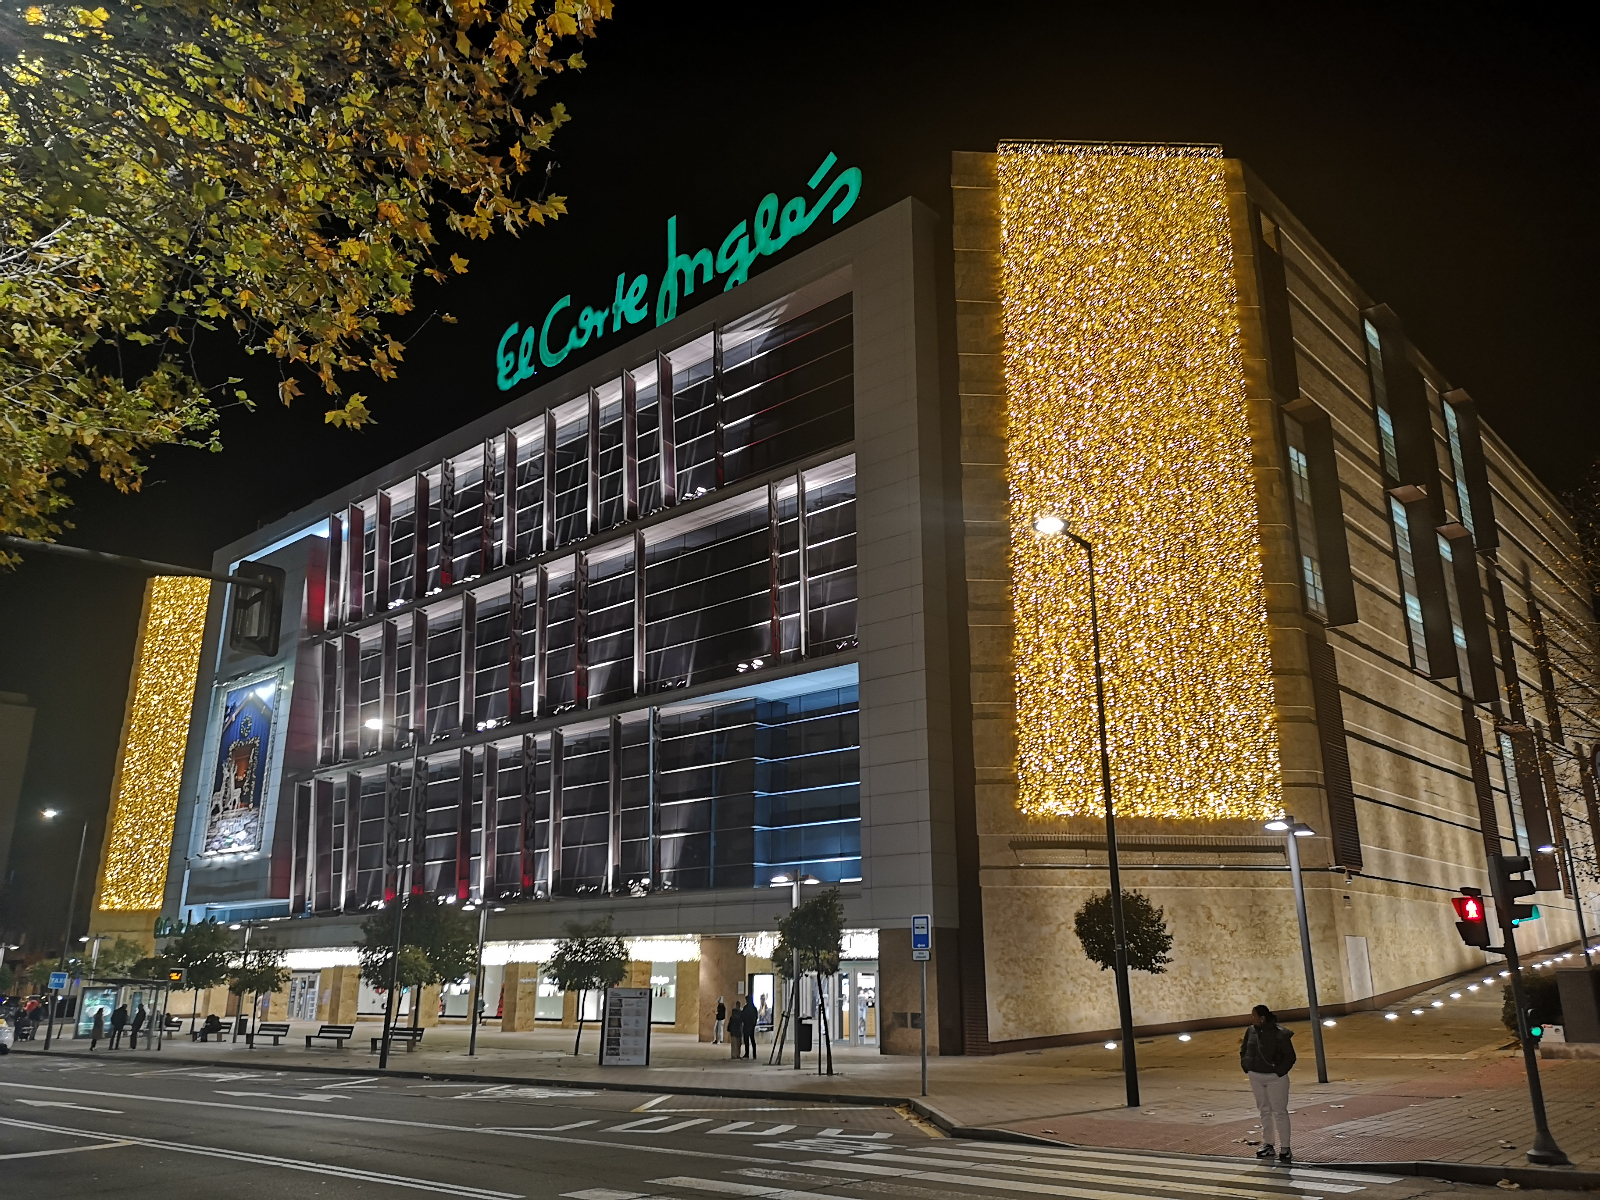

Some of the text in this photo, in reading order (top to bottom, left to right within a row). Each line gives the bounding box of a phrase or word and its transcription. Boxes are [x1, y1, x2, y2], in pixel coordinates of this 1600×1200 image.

[496, 151, 863, 392] El Corte Inglés
